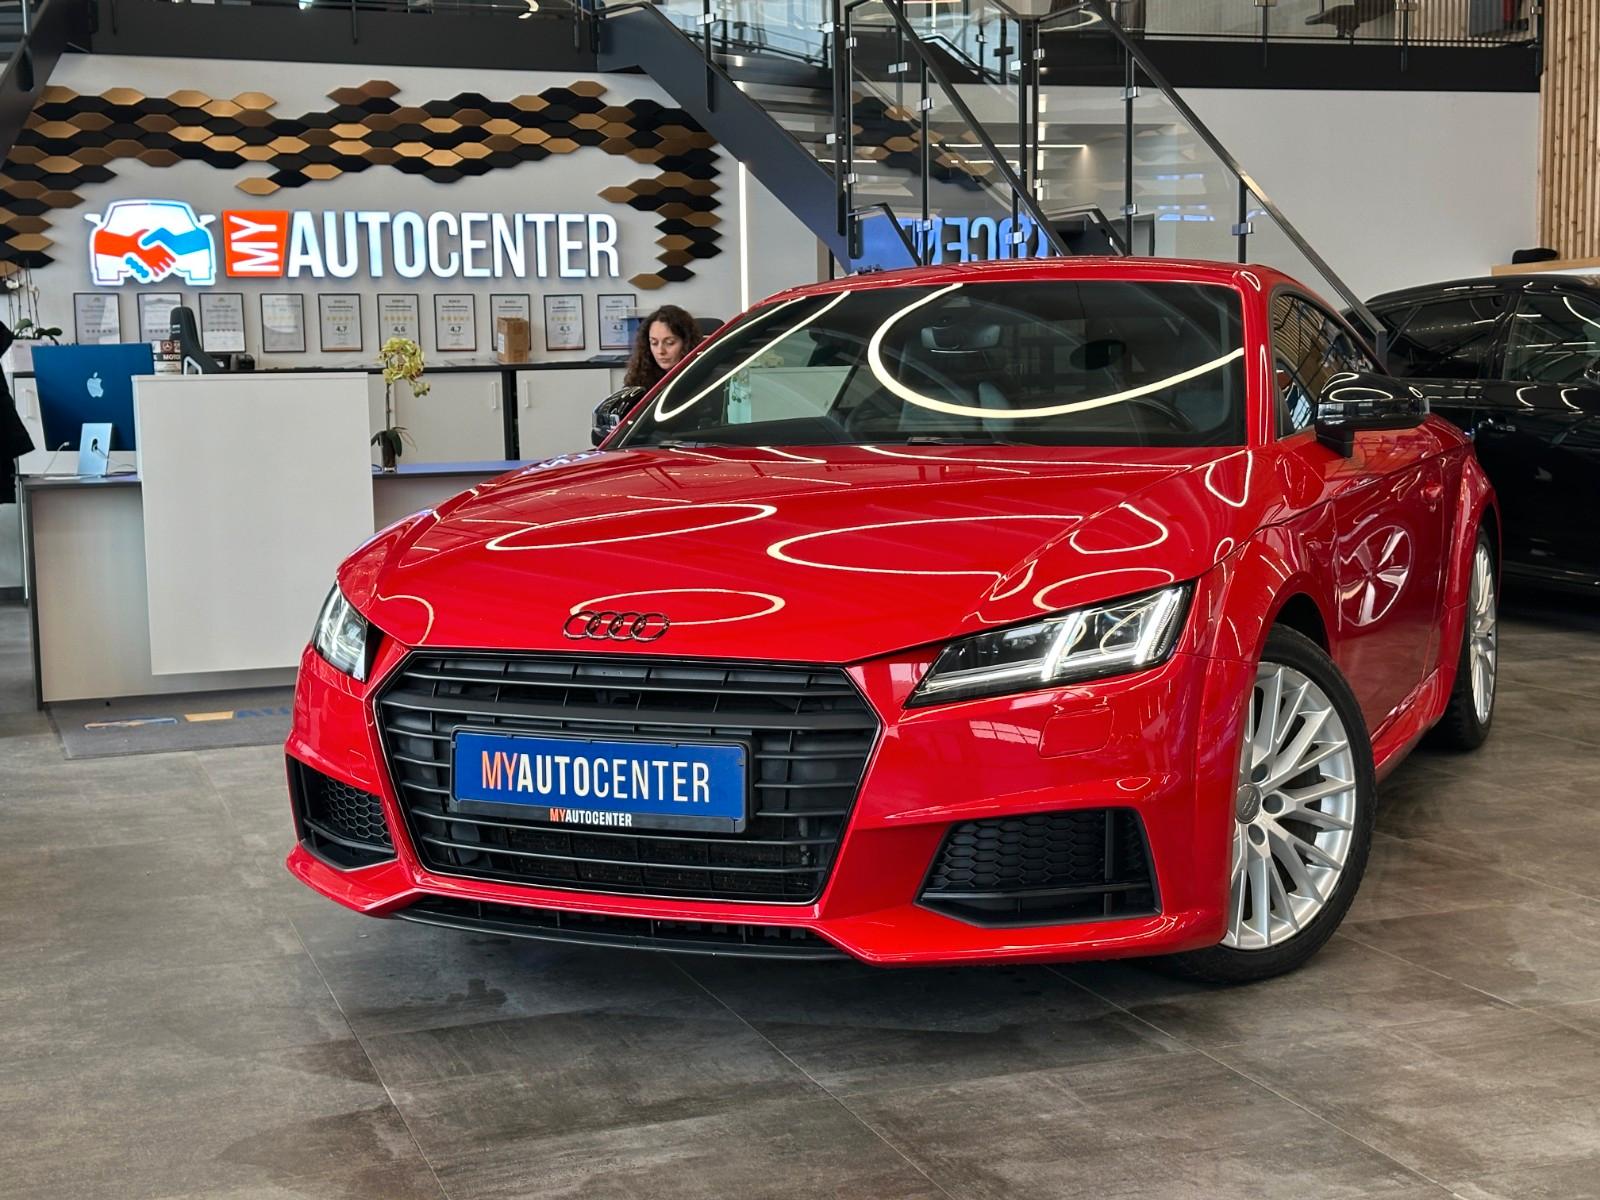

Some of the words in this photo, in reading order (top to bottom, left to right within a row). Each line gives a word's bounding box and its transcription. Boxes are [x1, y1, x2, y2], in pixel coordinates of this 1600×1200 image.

[229, 215, 280, 273] MY
[287, 210, 620, 279] AUTOCENTER
[481, 750, 711, 804] MYAUTOCENTER
[549, 807, 633, 828] MYAUTOCENTER
